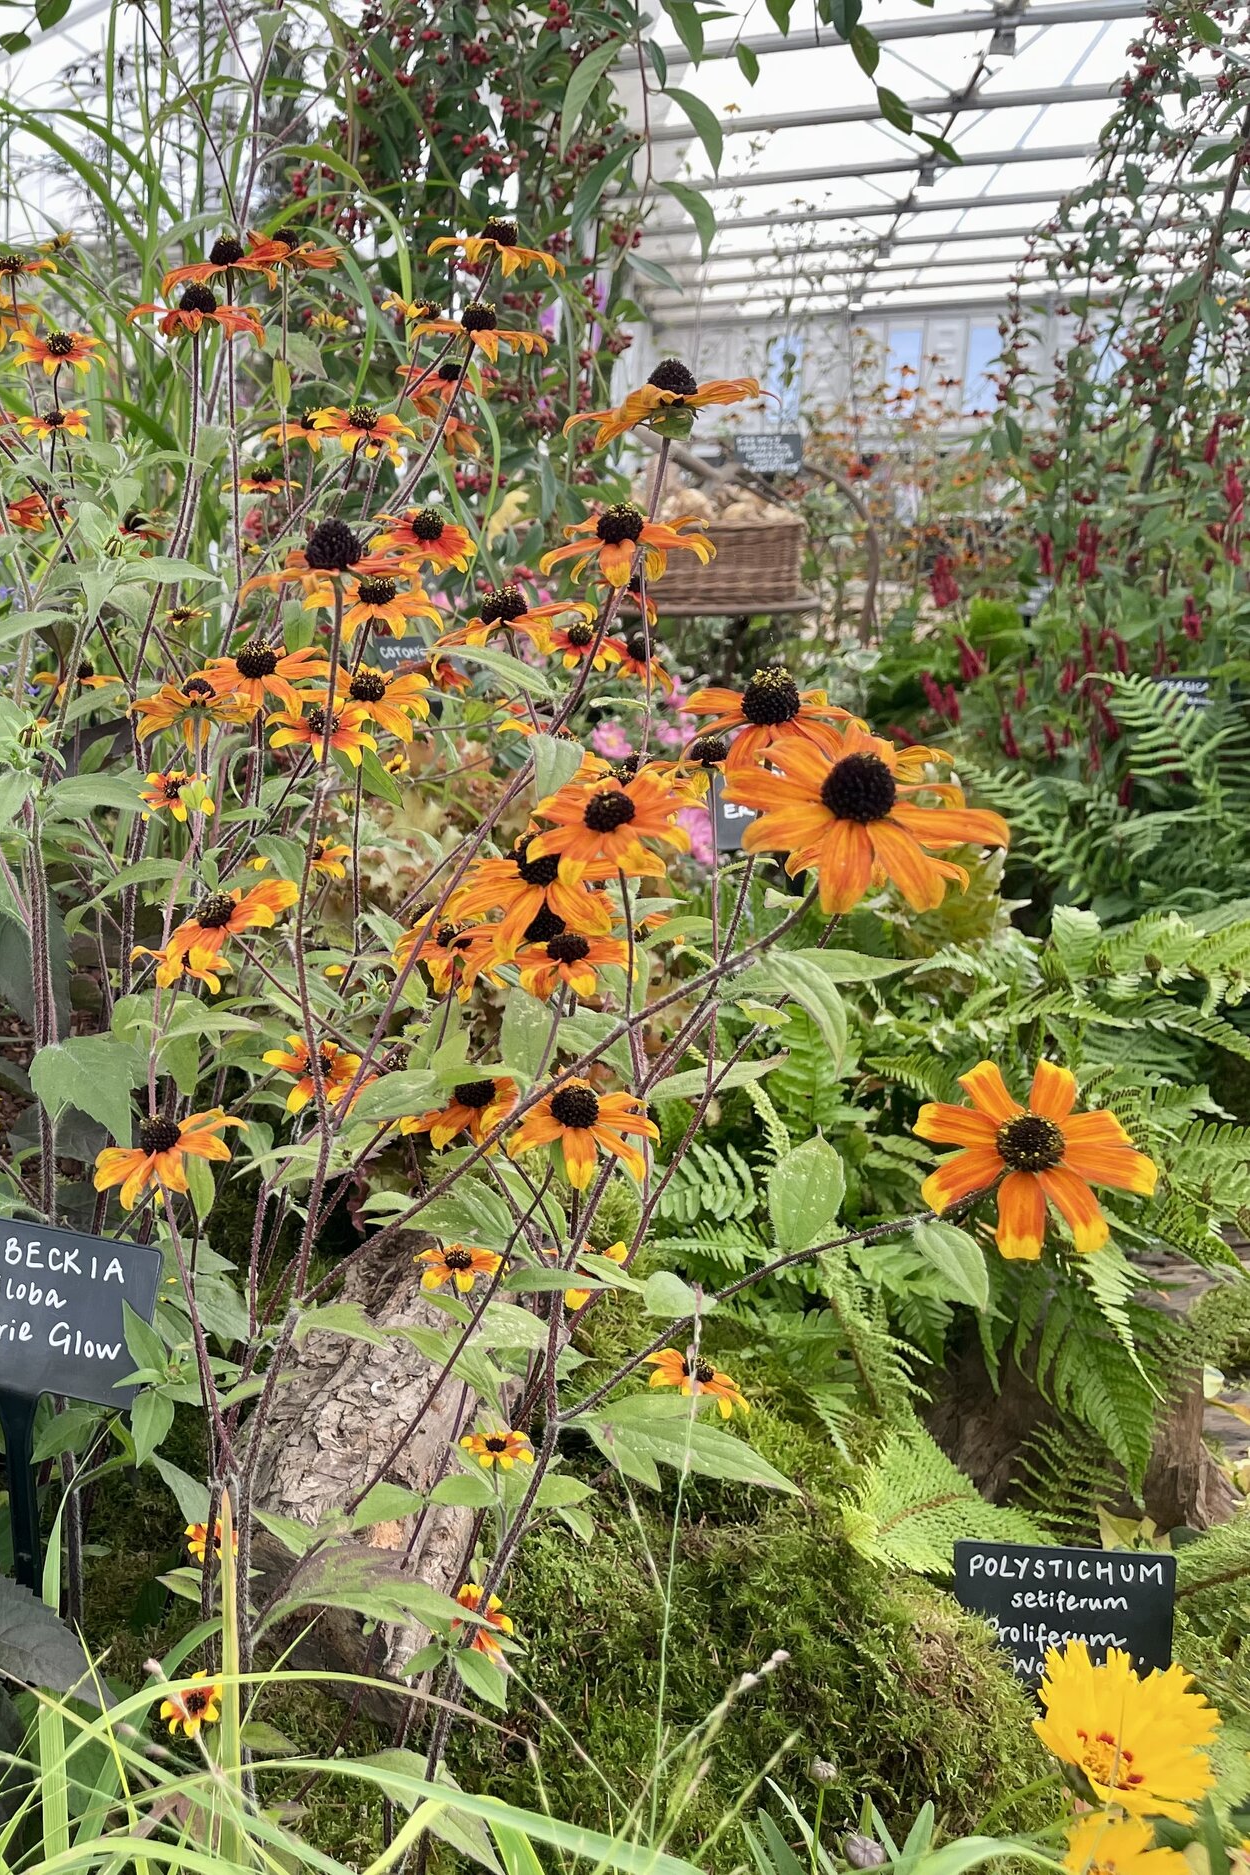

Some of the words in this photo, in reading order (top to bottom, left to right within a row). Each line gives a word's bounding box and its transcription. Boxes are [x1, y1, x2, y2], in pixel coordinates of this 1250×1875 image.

[48, 1322, 122, 1361] Glow
[969, 1554, 1164, 1586] POLYSTICHUM
[1010, 1589, 1129, 1613] setiferum
